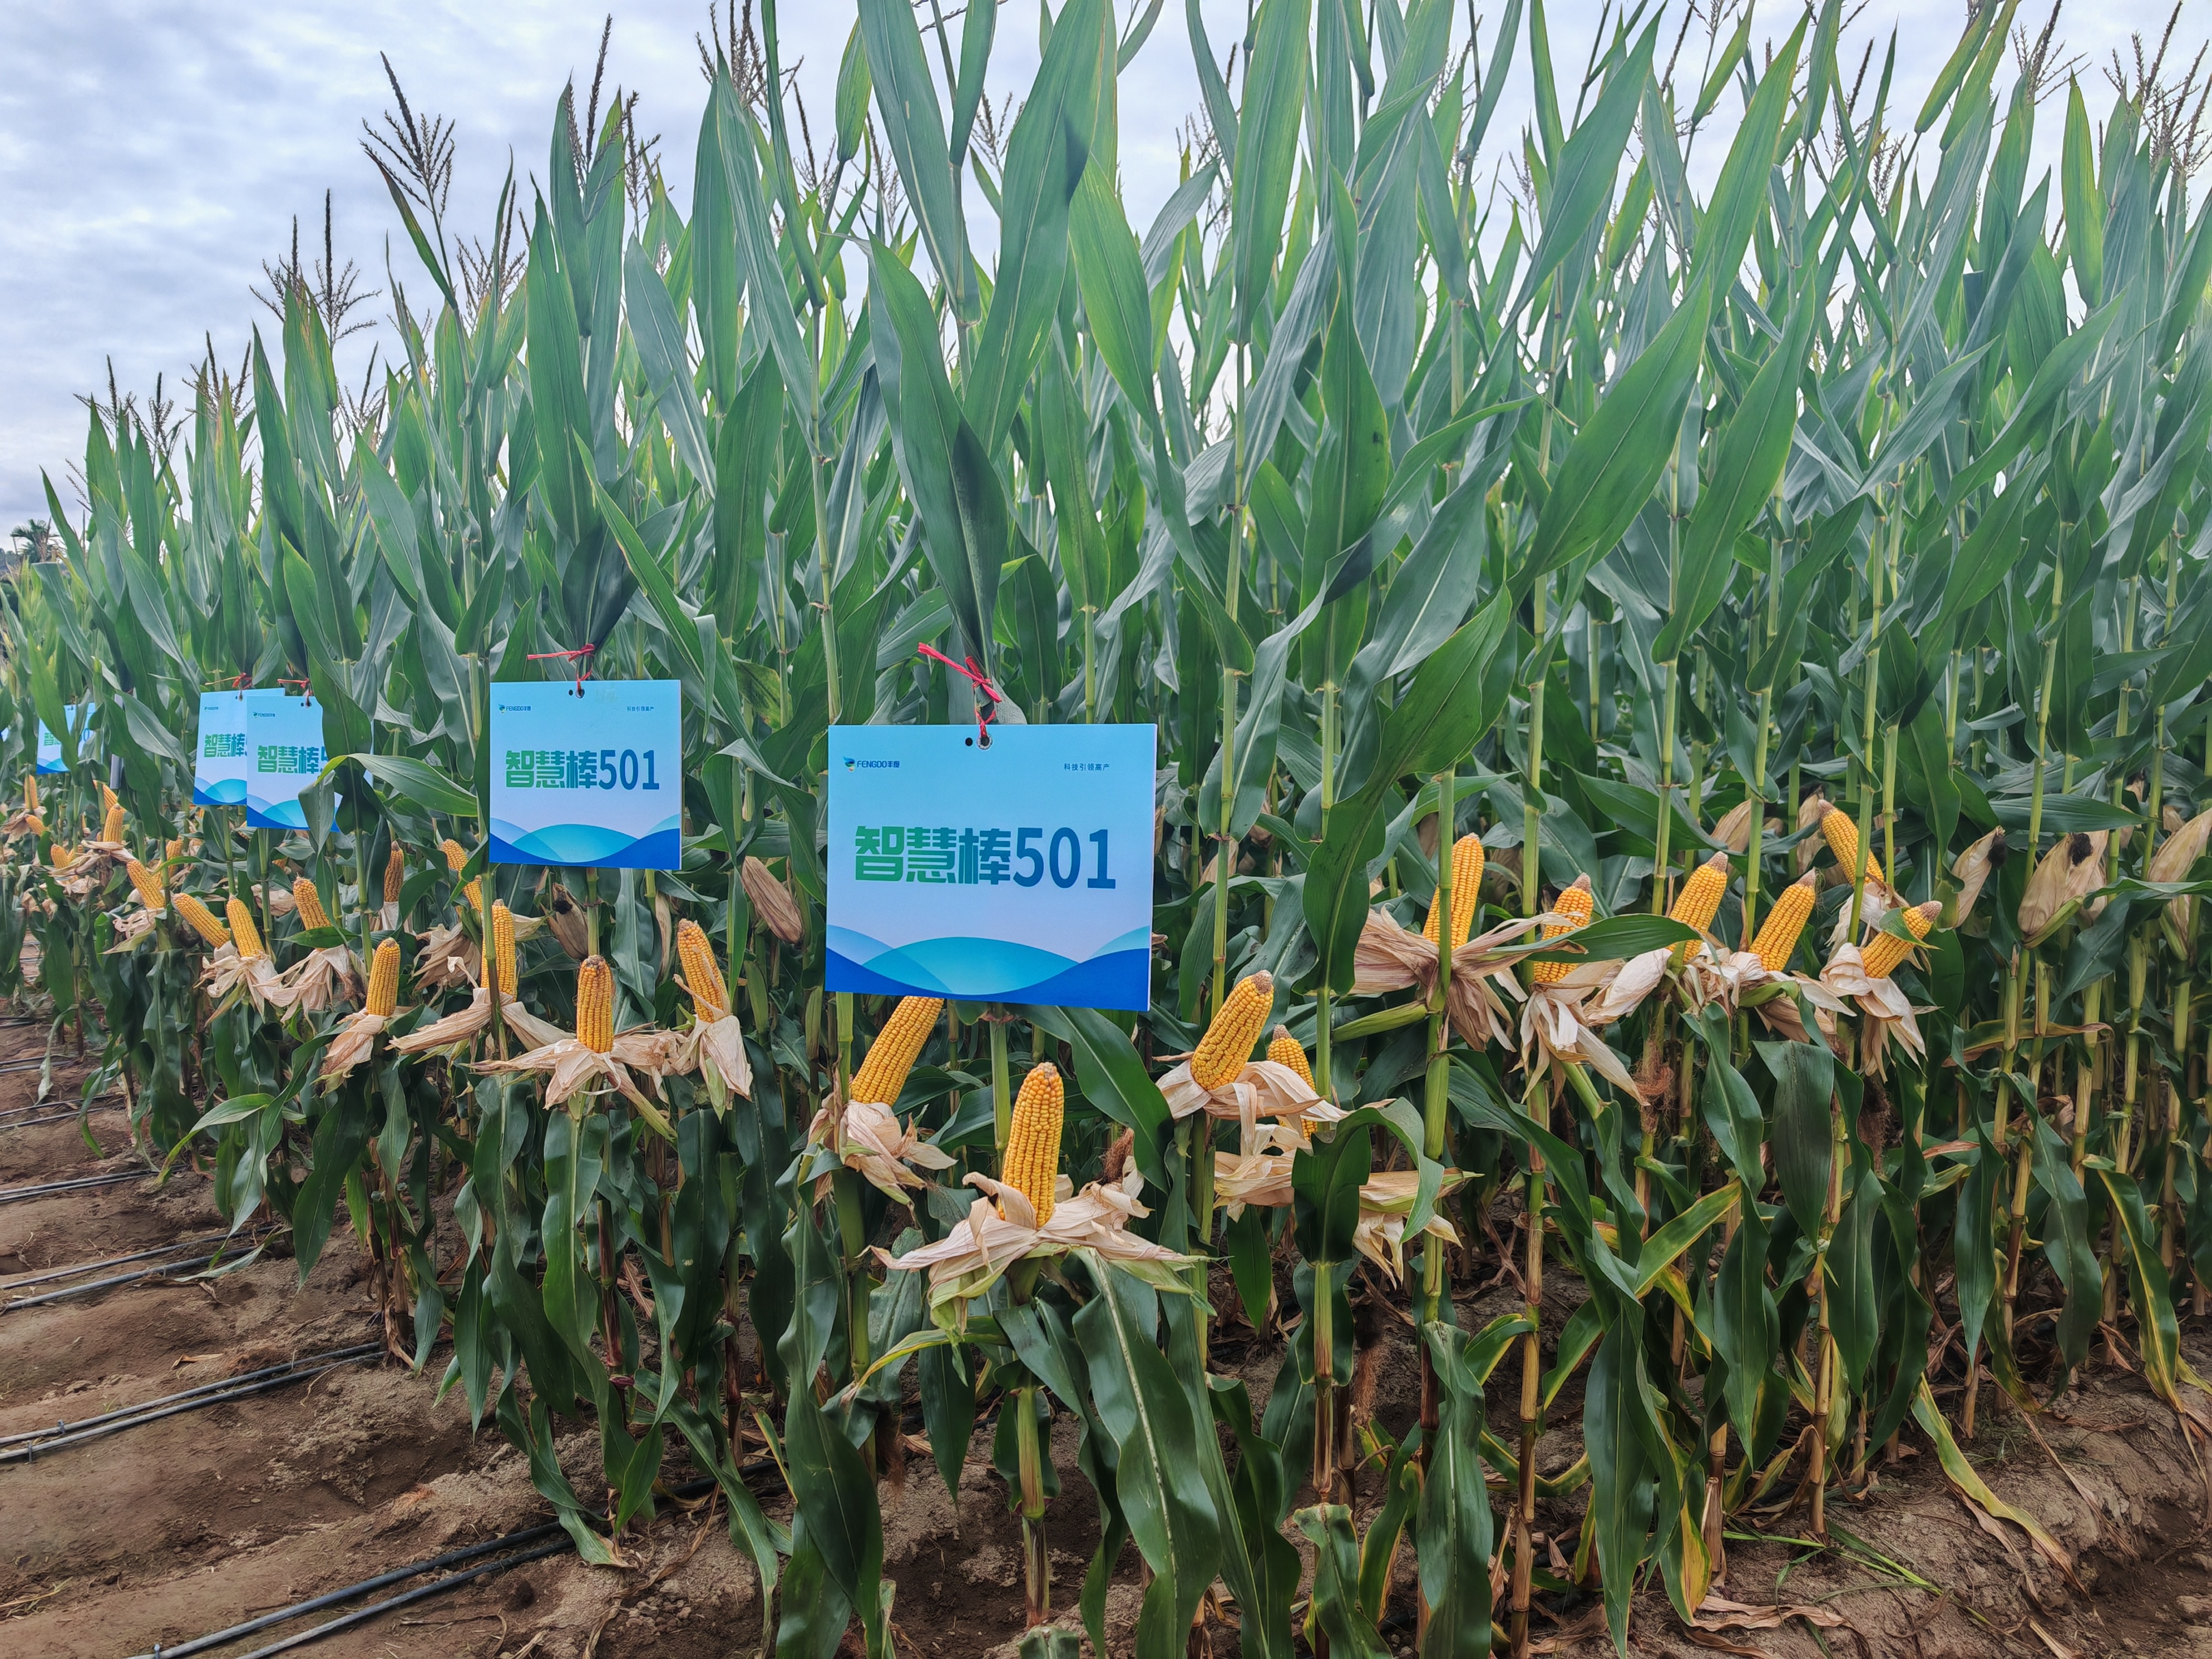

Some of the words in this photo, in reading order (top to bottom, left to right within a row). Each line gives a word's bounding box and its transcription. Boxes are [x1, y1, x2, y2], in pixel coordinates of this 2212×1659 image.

[204, 733, 247, 758] 智慧棒
[505, 749, 660, 790] 智慧棒501
[1064, 763, 1110, 771] 科技引领高产
[855, 826, 1116, 889] 智慧棒501
